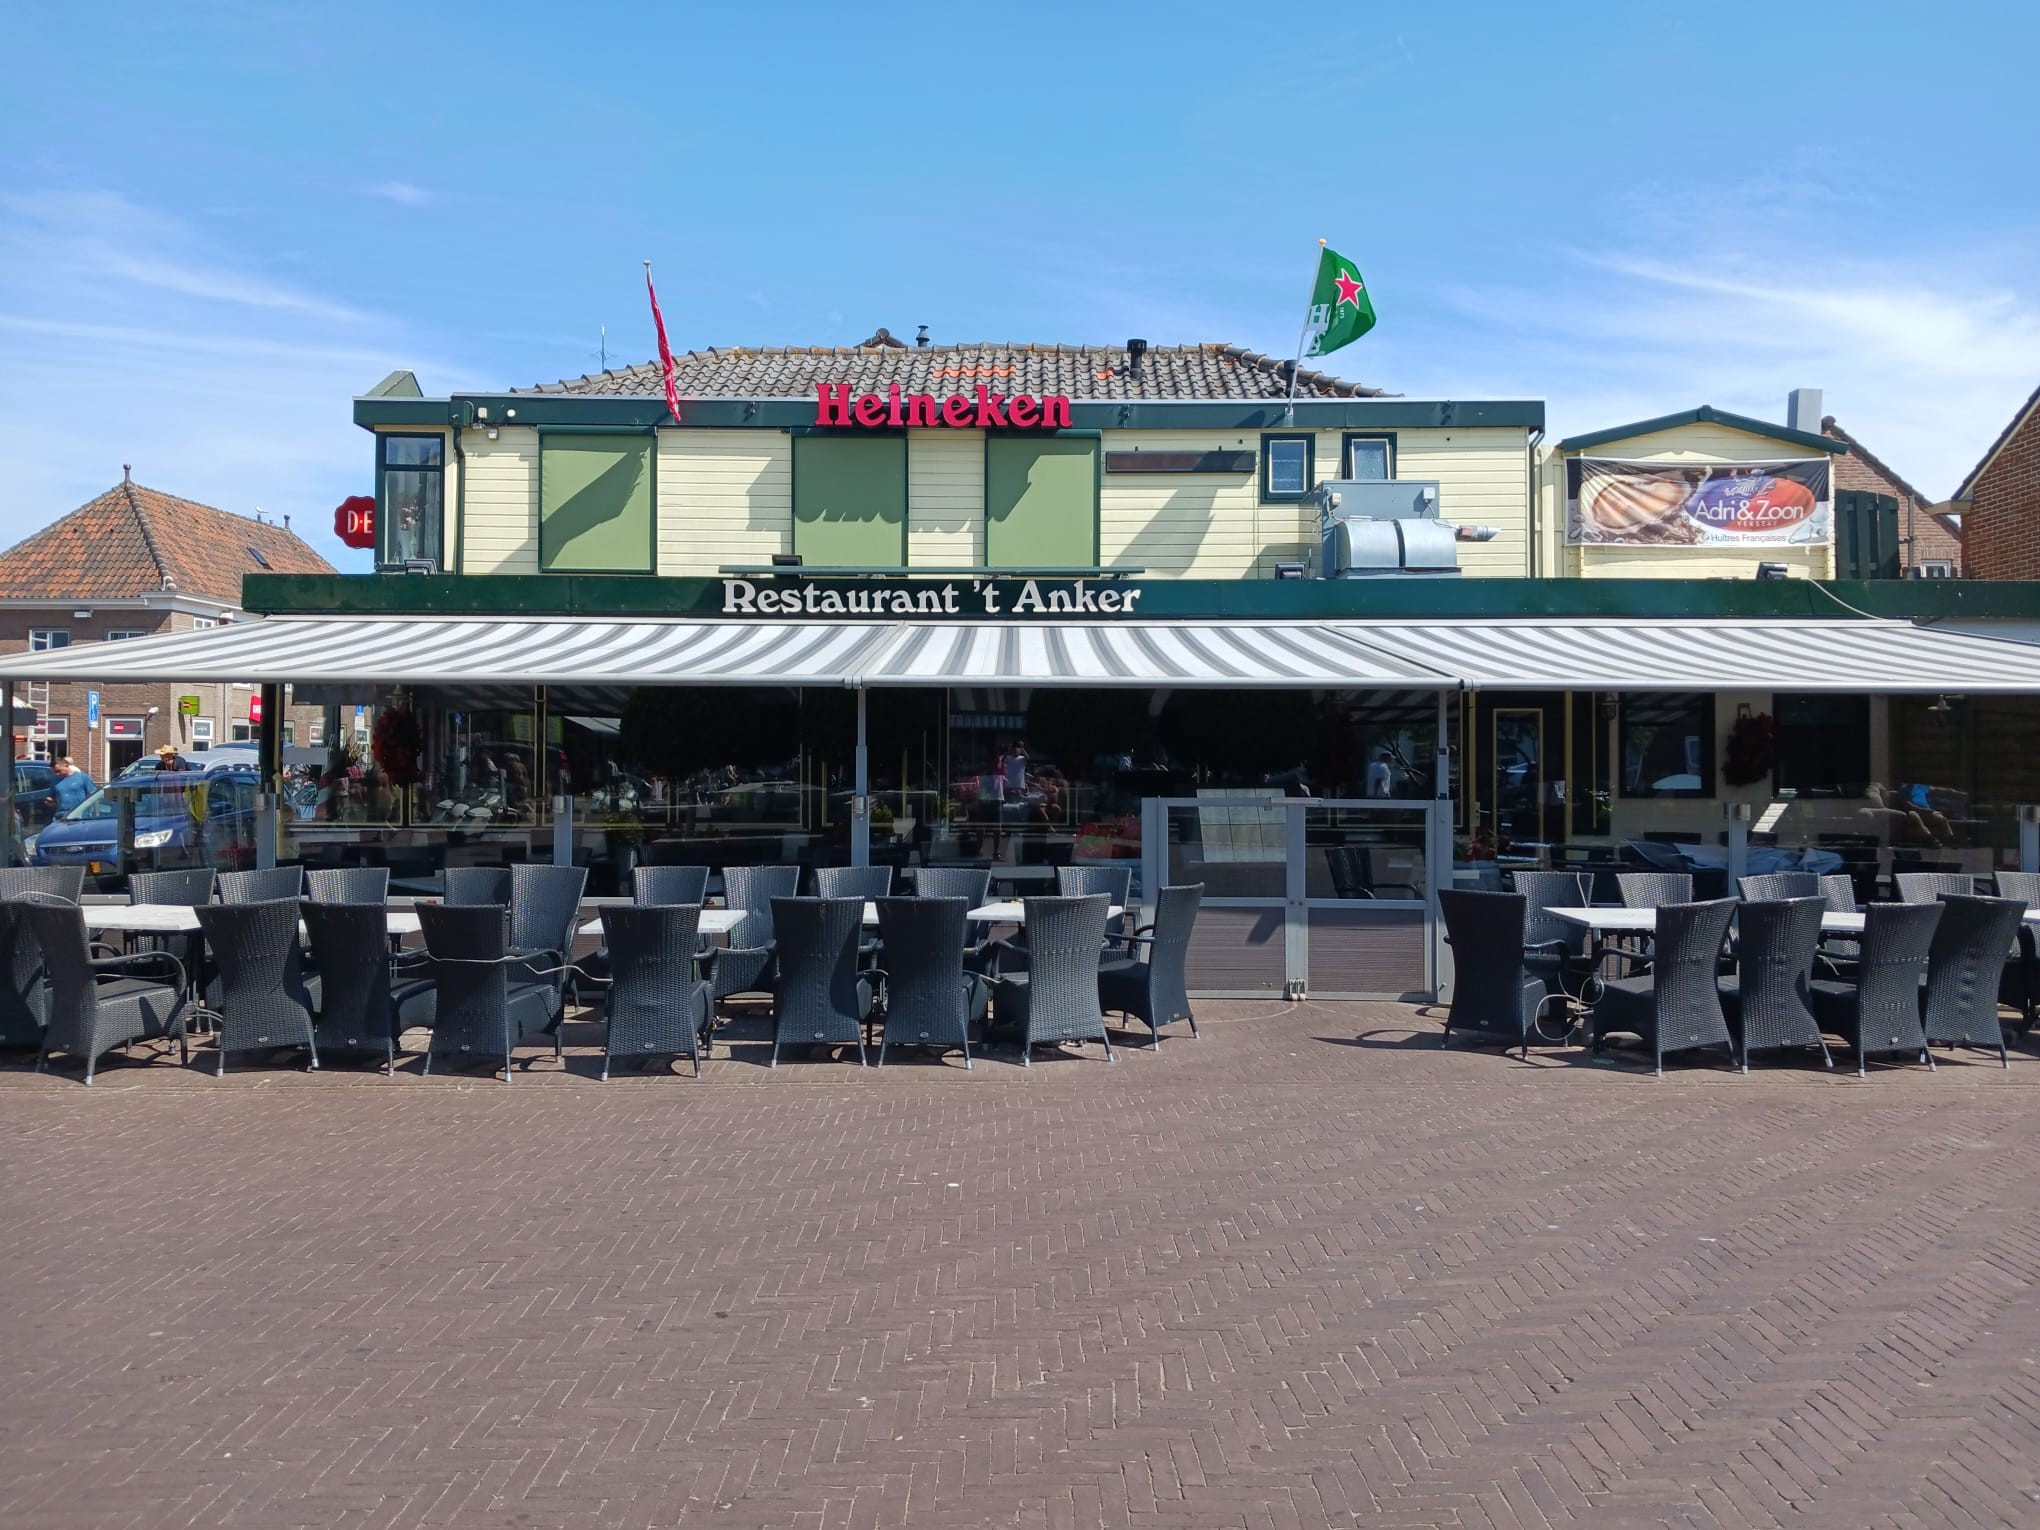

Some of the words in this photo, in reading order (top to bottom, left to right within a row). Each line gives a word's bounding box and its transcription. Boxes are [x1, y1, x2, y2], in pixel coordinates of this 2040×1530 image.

[815, 383, 1073, 428] Heineken
[722, 580, 960, 614] Restaurant
[1011, 579, 1141, 613] Anker
